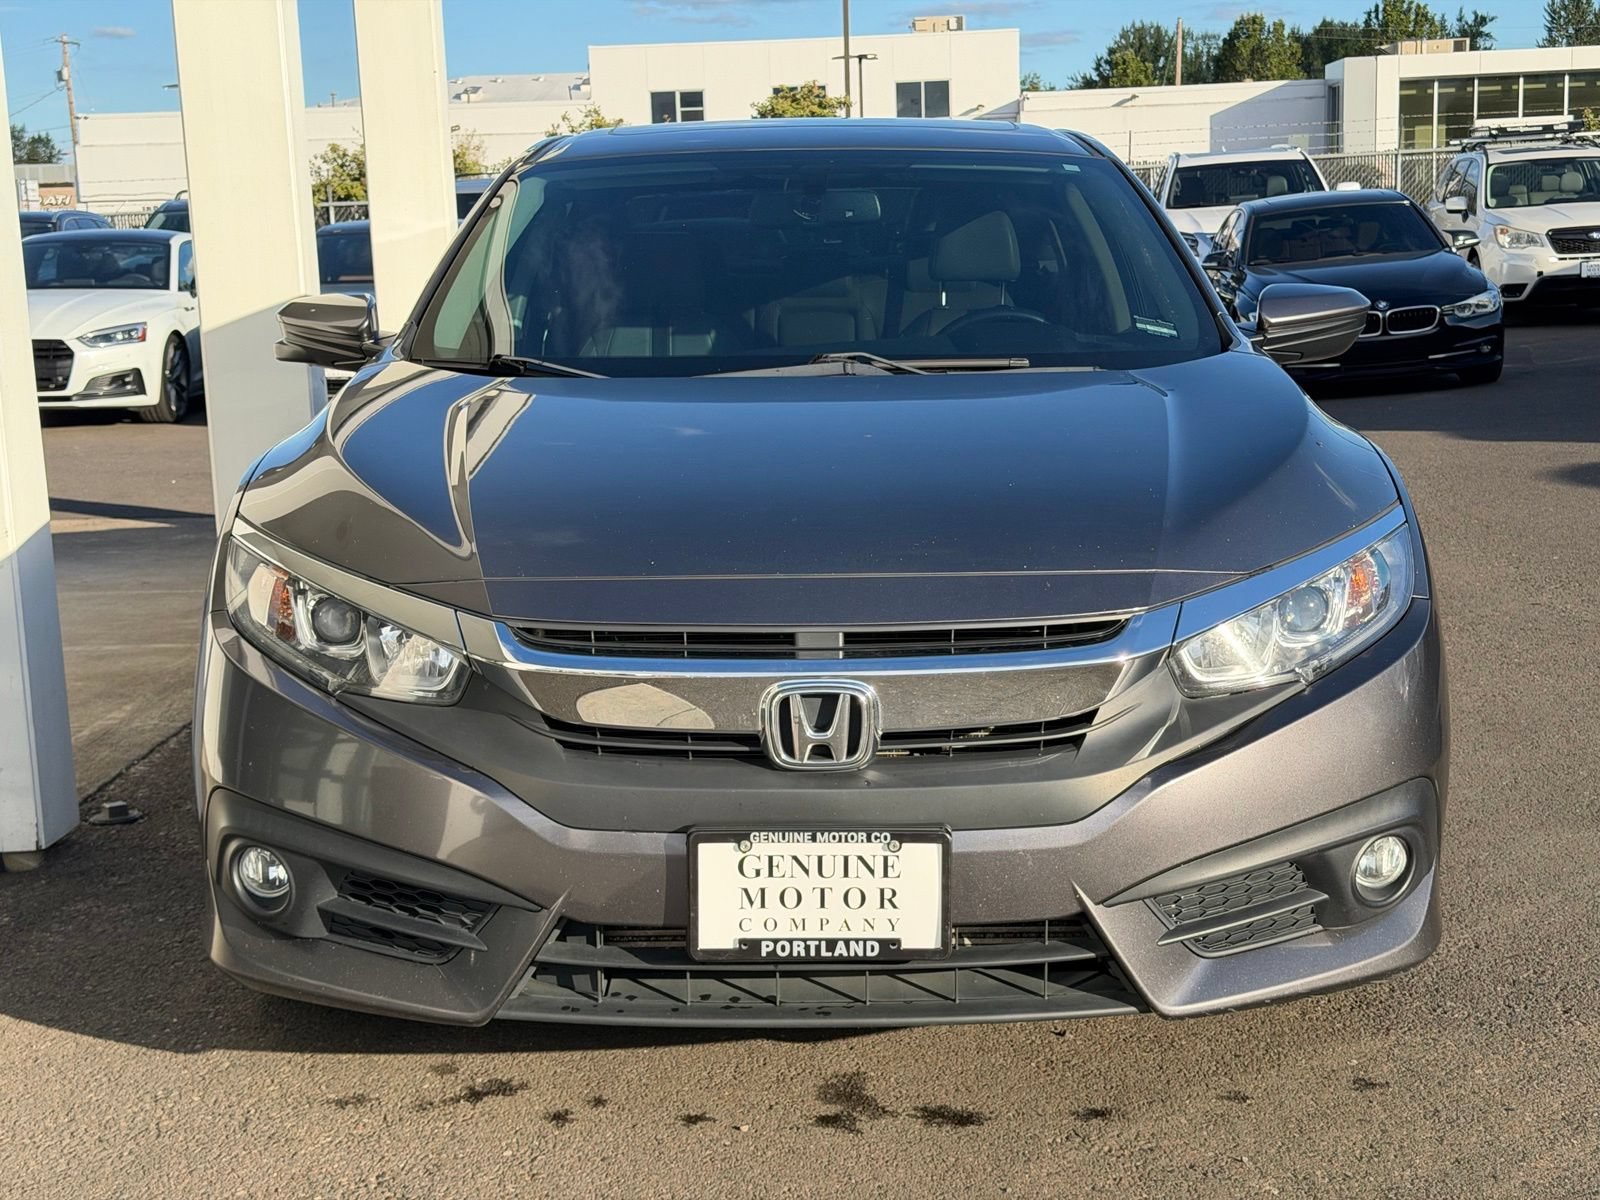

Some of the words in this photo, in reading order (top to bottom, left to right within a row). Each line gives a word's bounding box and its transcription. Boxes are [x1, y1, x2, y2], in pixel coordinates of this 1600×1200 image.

[750, 832, 812, 843] GENUINE
[816, 832, 867, 843] MOTOR
[871, 832, 891, 843] CO
[737, 854, 901, 879] GENUINE
[738, 886, 900, 910] MOTOR
[738, 917, 901, 932] COMPANY
[760, 940, 880, 957] PORTLAND
